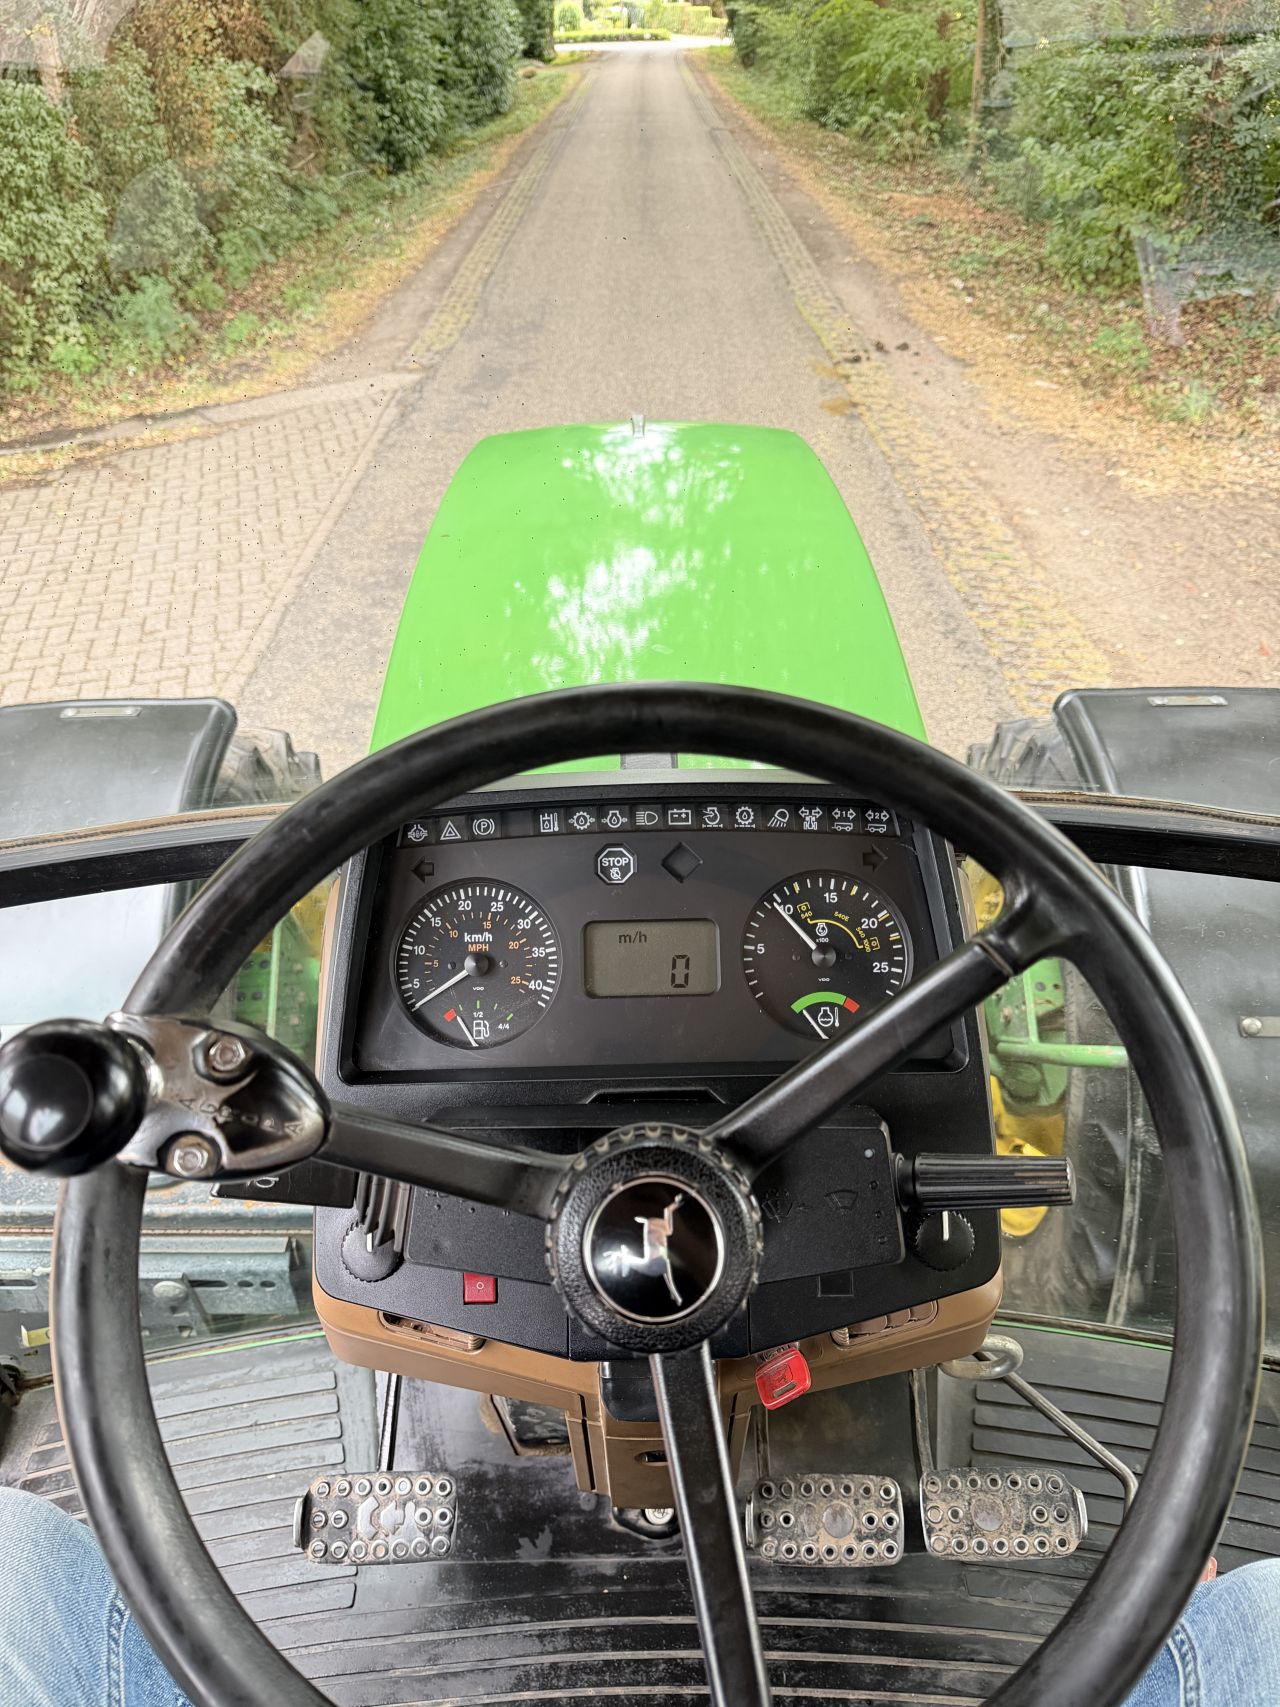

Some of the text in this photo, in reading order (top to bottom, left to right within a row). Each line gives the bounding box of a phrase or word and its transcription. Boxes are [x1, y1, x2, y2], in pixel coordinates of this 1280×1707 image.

[601, 857, 629, 866] STOP
[823, 892, 838, 903] 15
[457, 900, 472, 911] 20
[490, 901, 504, 912] 25
[429, 917, 442, 927] 15
[482, 921, 492, 929] 15
[517, 918, 531, 929] 30
[861, 917, 877, 929] 20
[449, 930, 459, 938] 10
[464, 932, 493, 943] km/h
[618, 930, 648, 944] m/h
[413, 945, 426, 955] 10
[468, 943, 489, 952] MPH
[508, 941, 519, 950] 20
[756, 943, 765, 954] 5
[532, 947, 546, 957] 35
[433, 959, 439, 968] 5
[872, 962, 889, 973] 25
[670, 954, 690, 989] 0
[412, 978, 420, 988] 5
[510, 976, 521, 985] 25
[528, 979, 543, 990] 40
